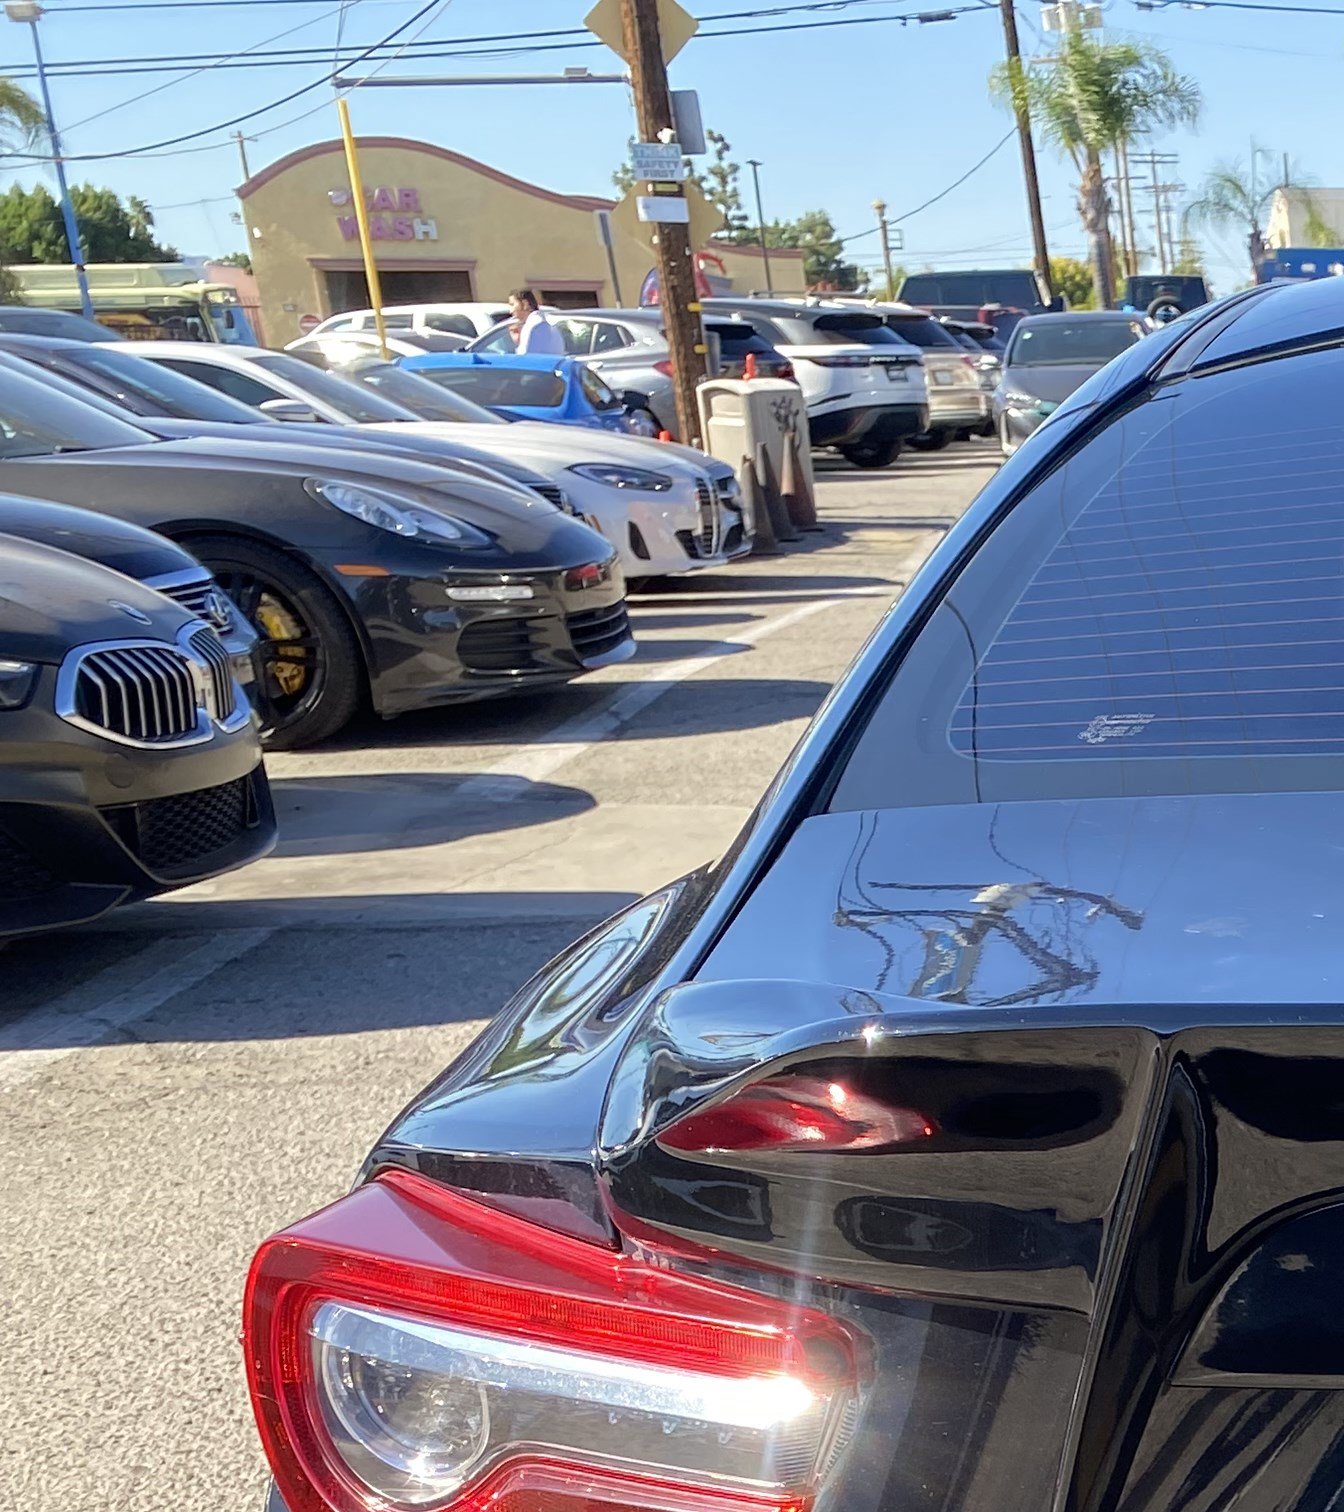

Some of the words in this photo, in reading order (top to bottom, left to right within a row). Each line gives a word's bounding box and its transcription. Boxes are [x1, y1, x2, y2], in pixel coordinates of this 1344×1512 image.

[636, 160, 680, 169] SAFETY
[643, 169, 676, 179] FIRST
[336, 216, 438, 241] WASH
